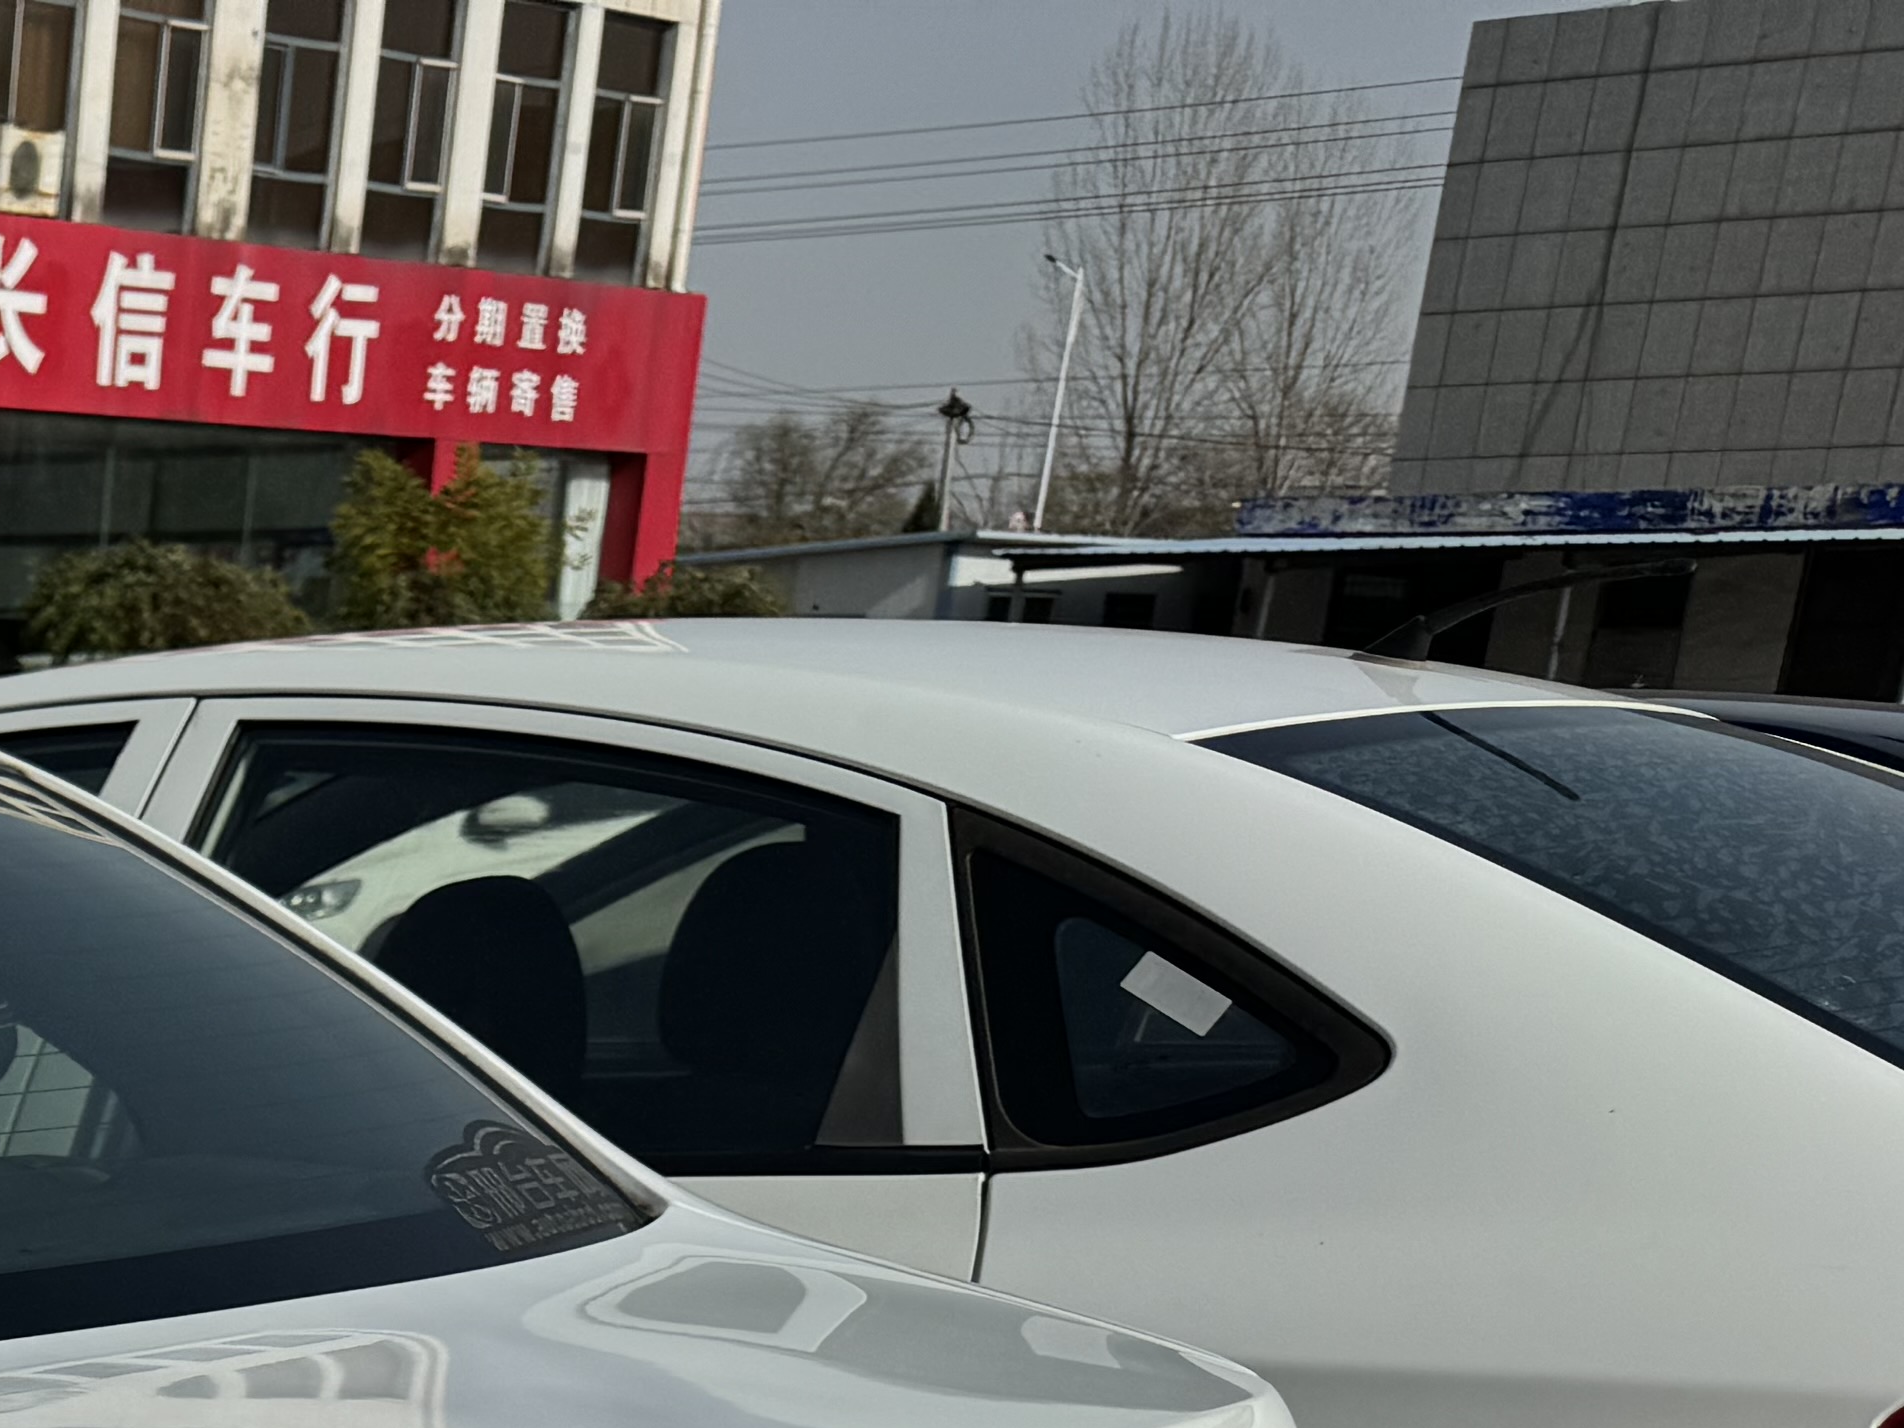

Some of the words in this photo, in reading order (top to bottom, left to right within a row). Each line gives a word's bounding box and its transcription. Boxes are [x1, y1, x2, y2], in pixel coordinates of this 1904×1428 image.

[433, 294, 587, 354] 分期置换
[423, 361, 580, 422] 车辆寄售
